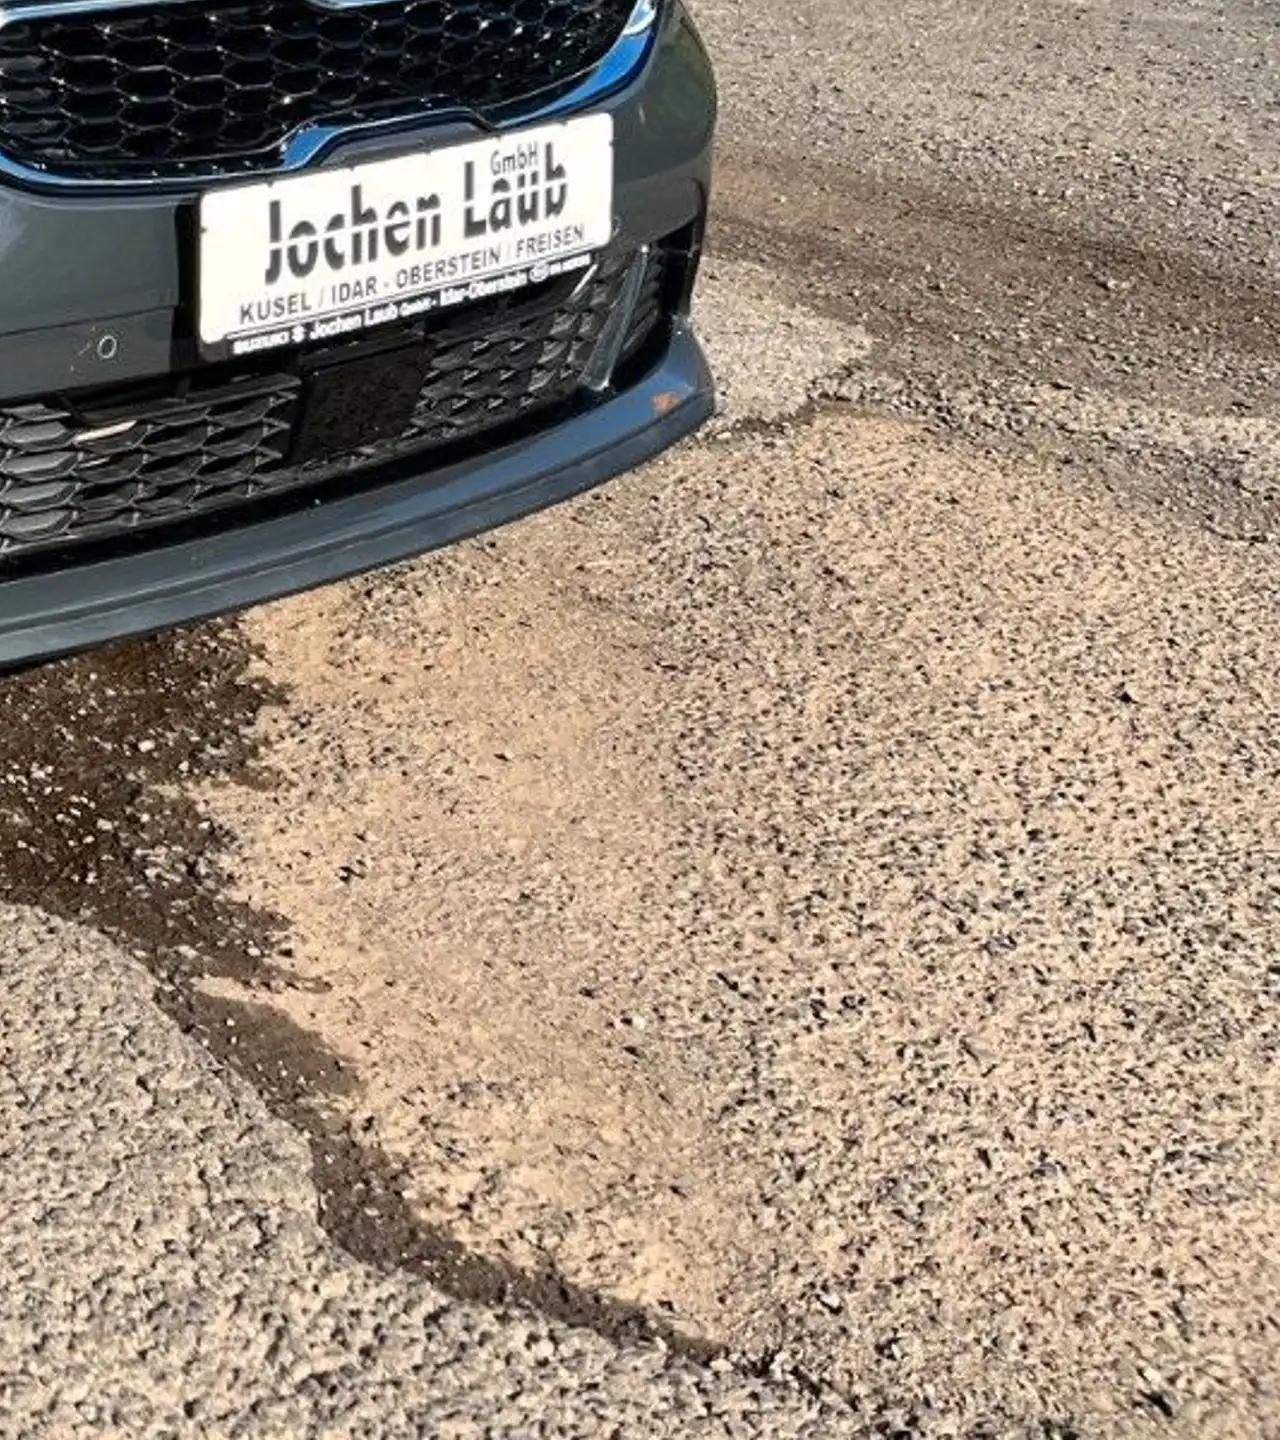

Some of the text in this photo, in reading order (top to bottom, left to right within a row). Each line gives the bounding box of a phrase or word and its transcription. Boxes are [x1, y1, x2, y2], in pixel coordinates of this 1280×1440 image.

[490, 141, 539, 176] GmbH
[264, 141, 568, 286] Jochen Laub
[239, 291, 312, 325] KUSEL
[331, 275, 378, 306] IDAR
[396, 242, 502, 289] OBERSTEIN
[515, 223, 585, 258] FREISEN
